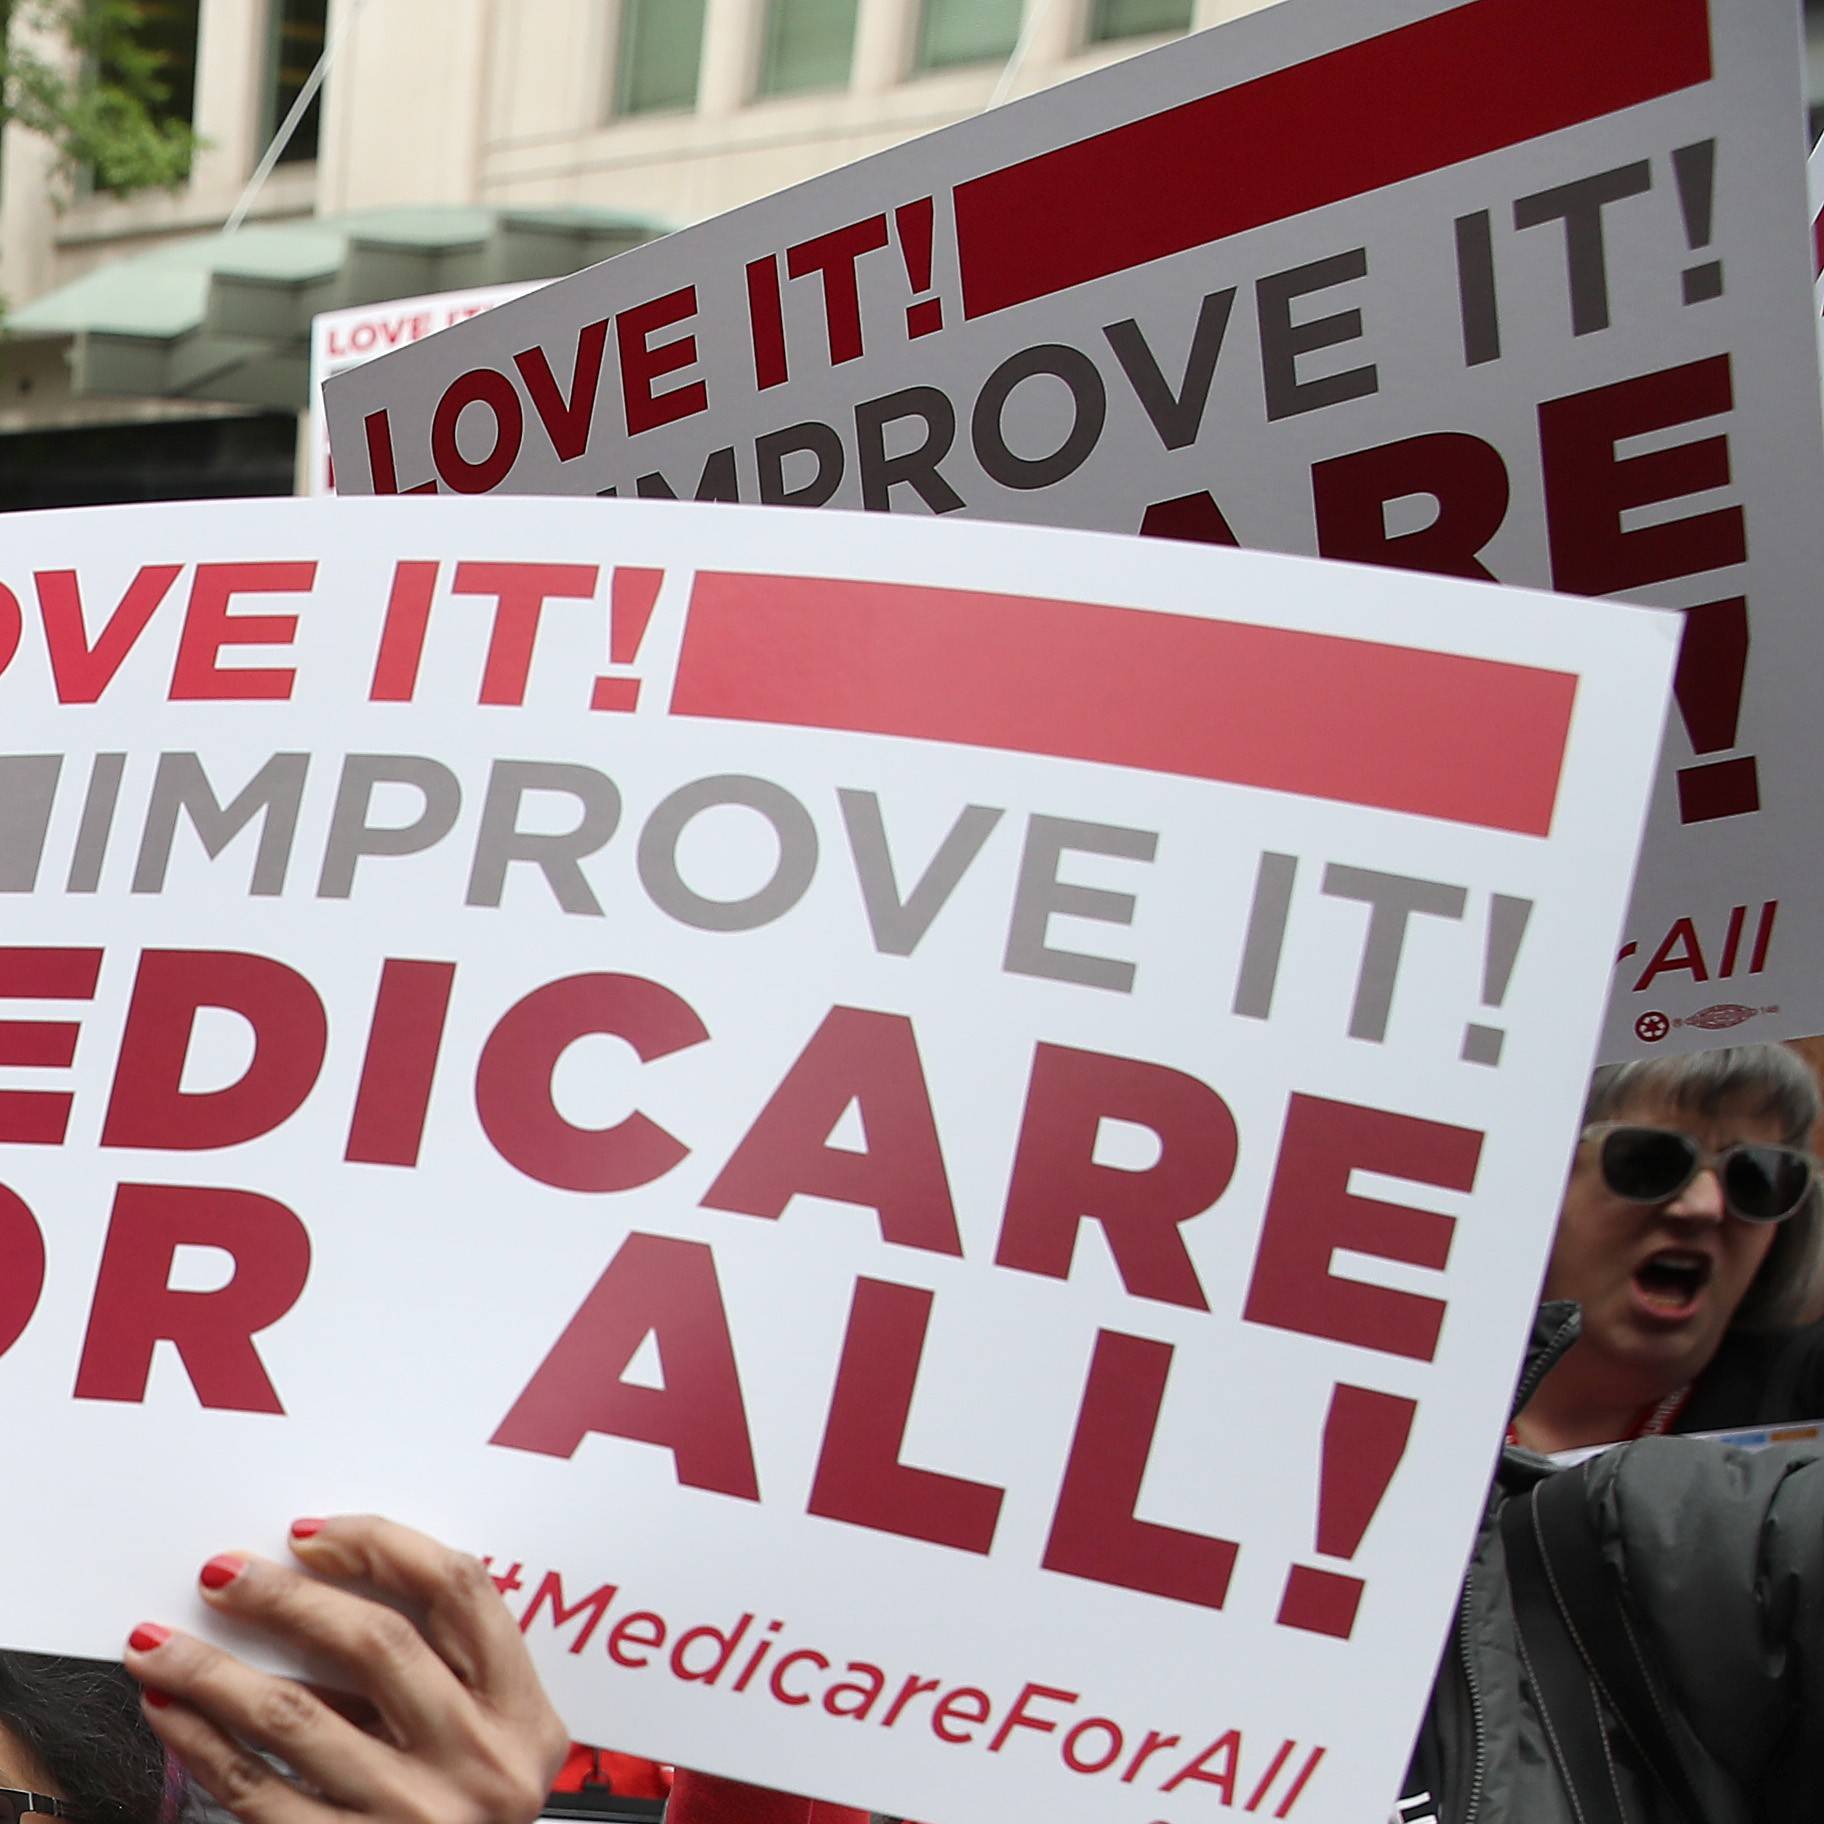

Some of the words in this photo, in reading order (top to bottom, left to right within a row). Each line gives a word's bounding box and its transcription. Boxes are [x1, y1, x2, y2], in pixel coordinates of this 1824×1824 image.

[363, 284, 710, 495] LOVE
[745, 195, 944, 392] IT!
[1453, 138, 1724, 368] IT!
[368, 560, 665, 714] IT!
[65, 751, 1159, 995] IMPROVE
[1231, 849, 1535, 1068] IT!
[486, 1229, 1418, 1640] ALL!
[482, 1554, 1327, 1819] #MedicareForAll
